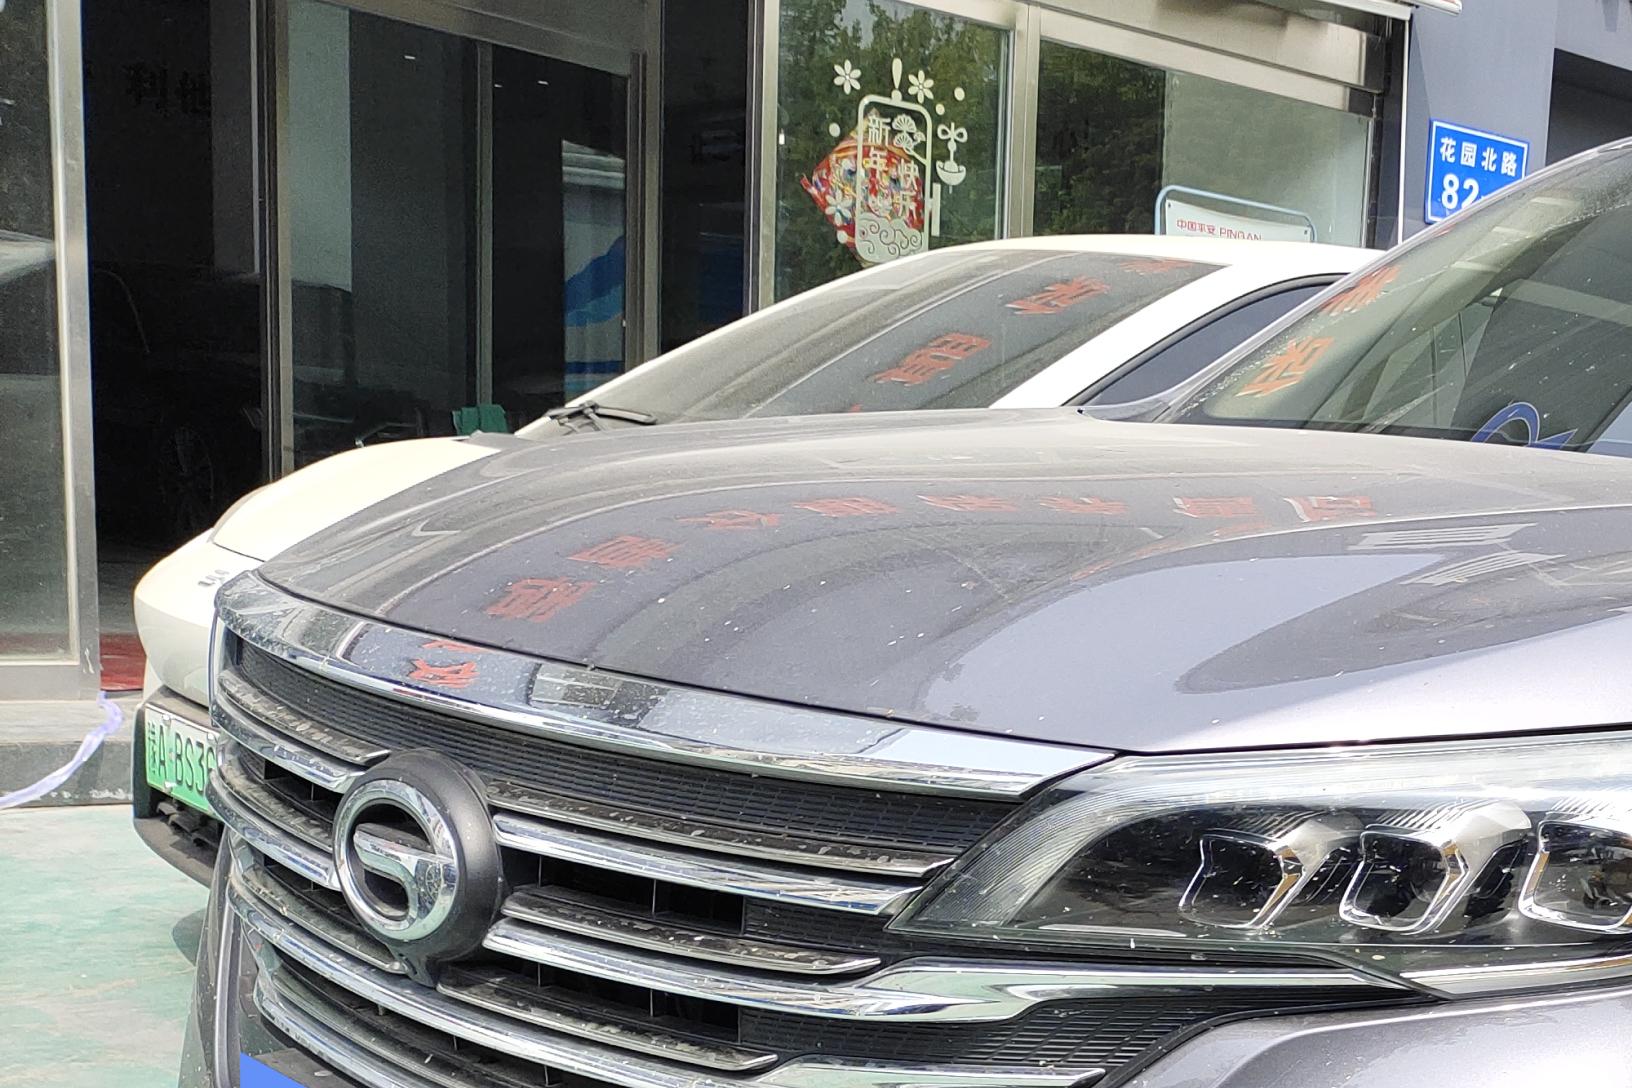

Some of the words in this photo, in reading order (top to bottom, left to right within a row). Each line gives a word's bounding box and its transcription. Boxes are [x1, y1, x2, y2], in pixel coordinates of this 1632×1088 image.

[1440, 136, 1517, 177] 花园北路
[1177, 219, 1216, 236] 中国平安
